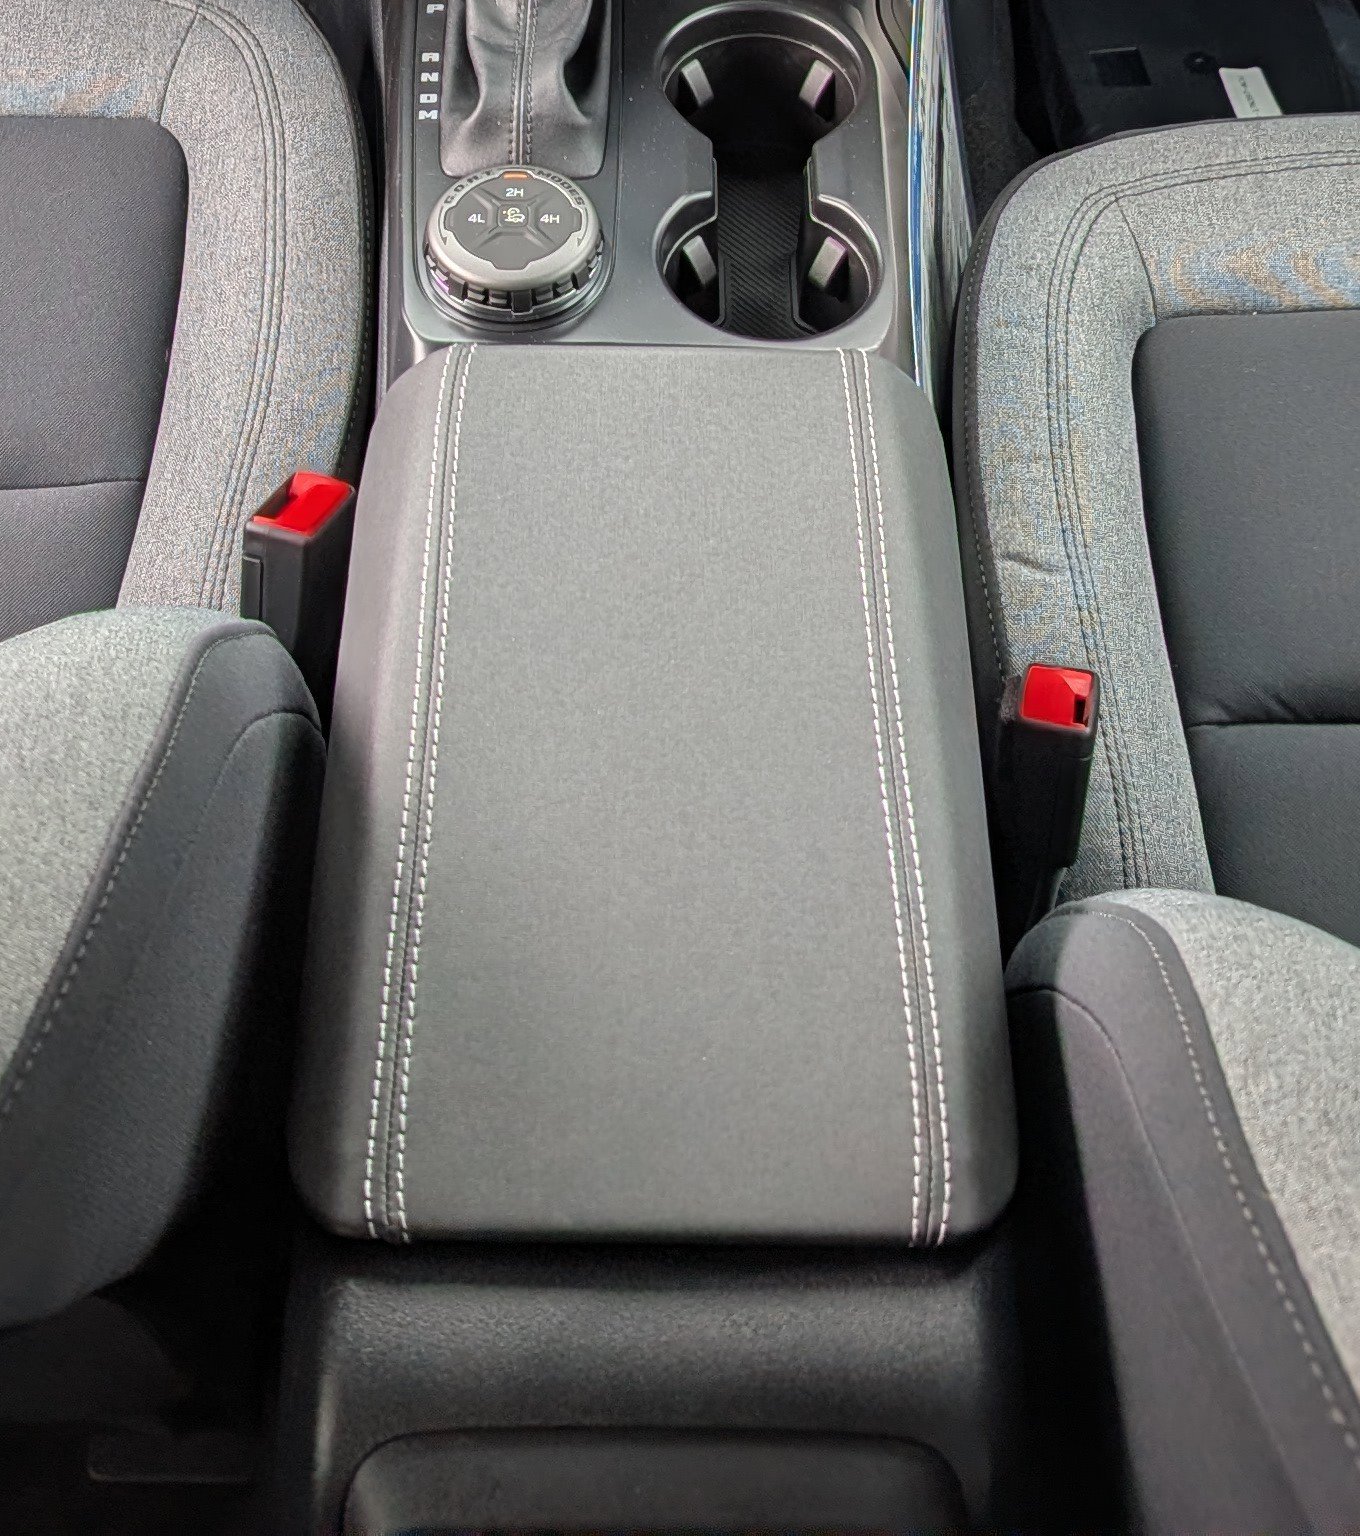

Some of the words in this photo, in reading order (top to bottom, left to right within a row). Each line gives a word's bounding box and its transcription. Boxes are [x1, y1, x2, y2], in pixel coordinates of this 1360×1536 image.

[426, 3, 444, 13] P
[420, 72, 439, 83] N
[418, 109, 438, 120] M
[505, 187, 524, 197] 2H
[467, 213, 486, 223] 4L
[540, 214, 560, 224] 4H
